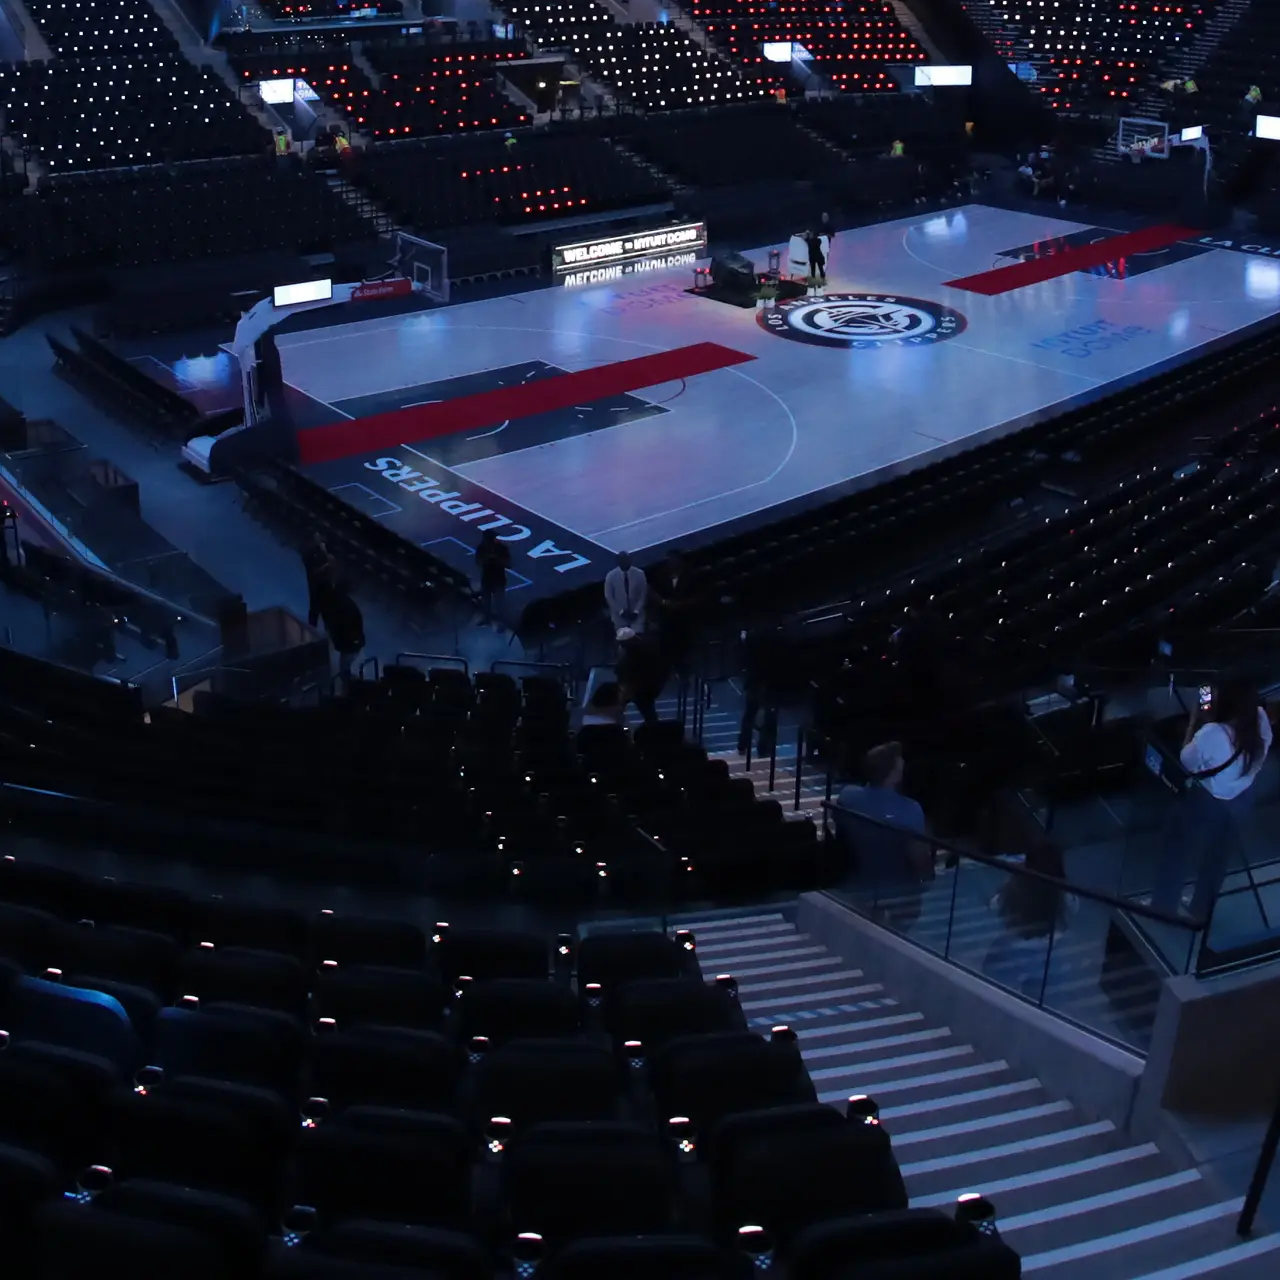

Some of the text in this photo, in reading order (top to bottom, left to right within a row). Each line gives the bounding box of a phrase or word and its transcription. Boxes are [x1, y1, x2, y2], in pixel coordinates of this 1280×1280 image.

[564, 241, 623, 262] WELCOME
[634, 234, 667, 250] INTUIT
[1199, 237, 1233, 247] LA
[767, 295, 896, 331] LOS ANGELES
[363, 457, 593, 573] LA CLIPPERS
